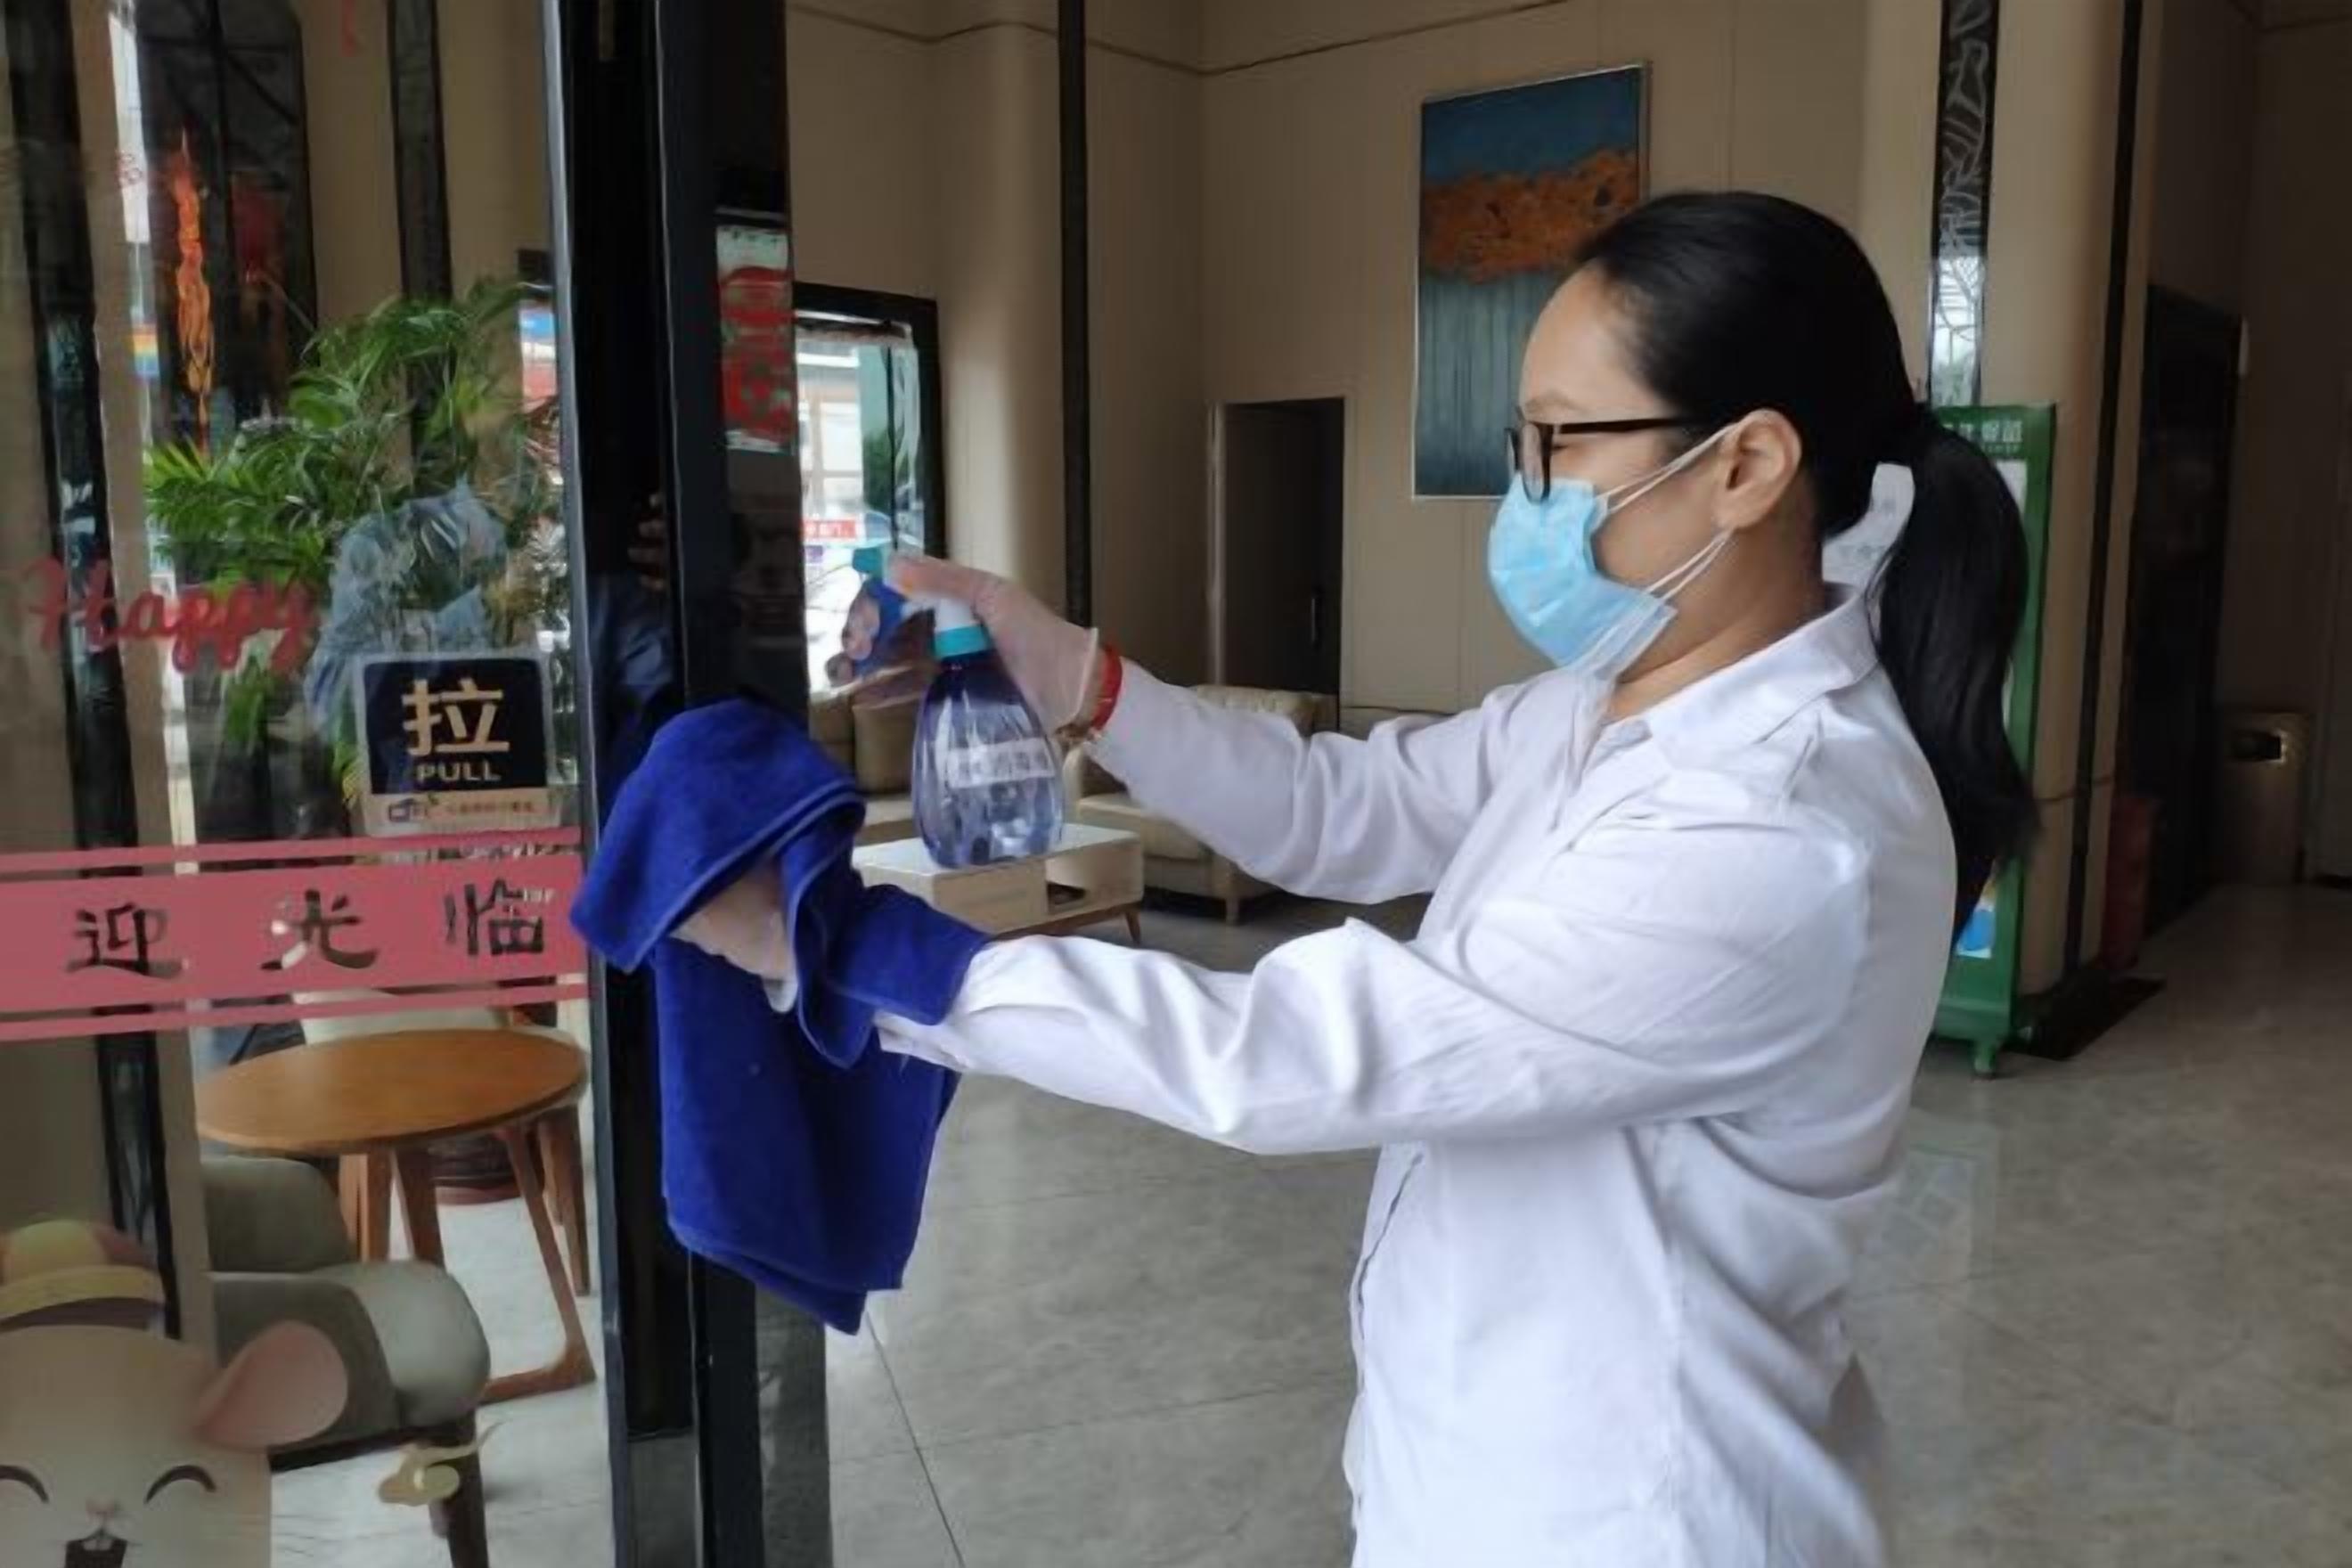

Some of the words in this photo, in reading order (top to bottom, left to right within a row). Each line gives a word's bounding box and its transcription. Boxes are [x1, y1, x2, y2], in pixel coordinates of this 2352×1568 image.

[21, 556, 317, 675] Happy
[401, 676, 510, 756] 拉
[415, 759, 502, 783] PULL
[66, 878, 554, 978] 迎光临
